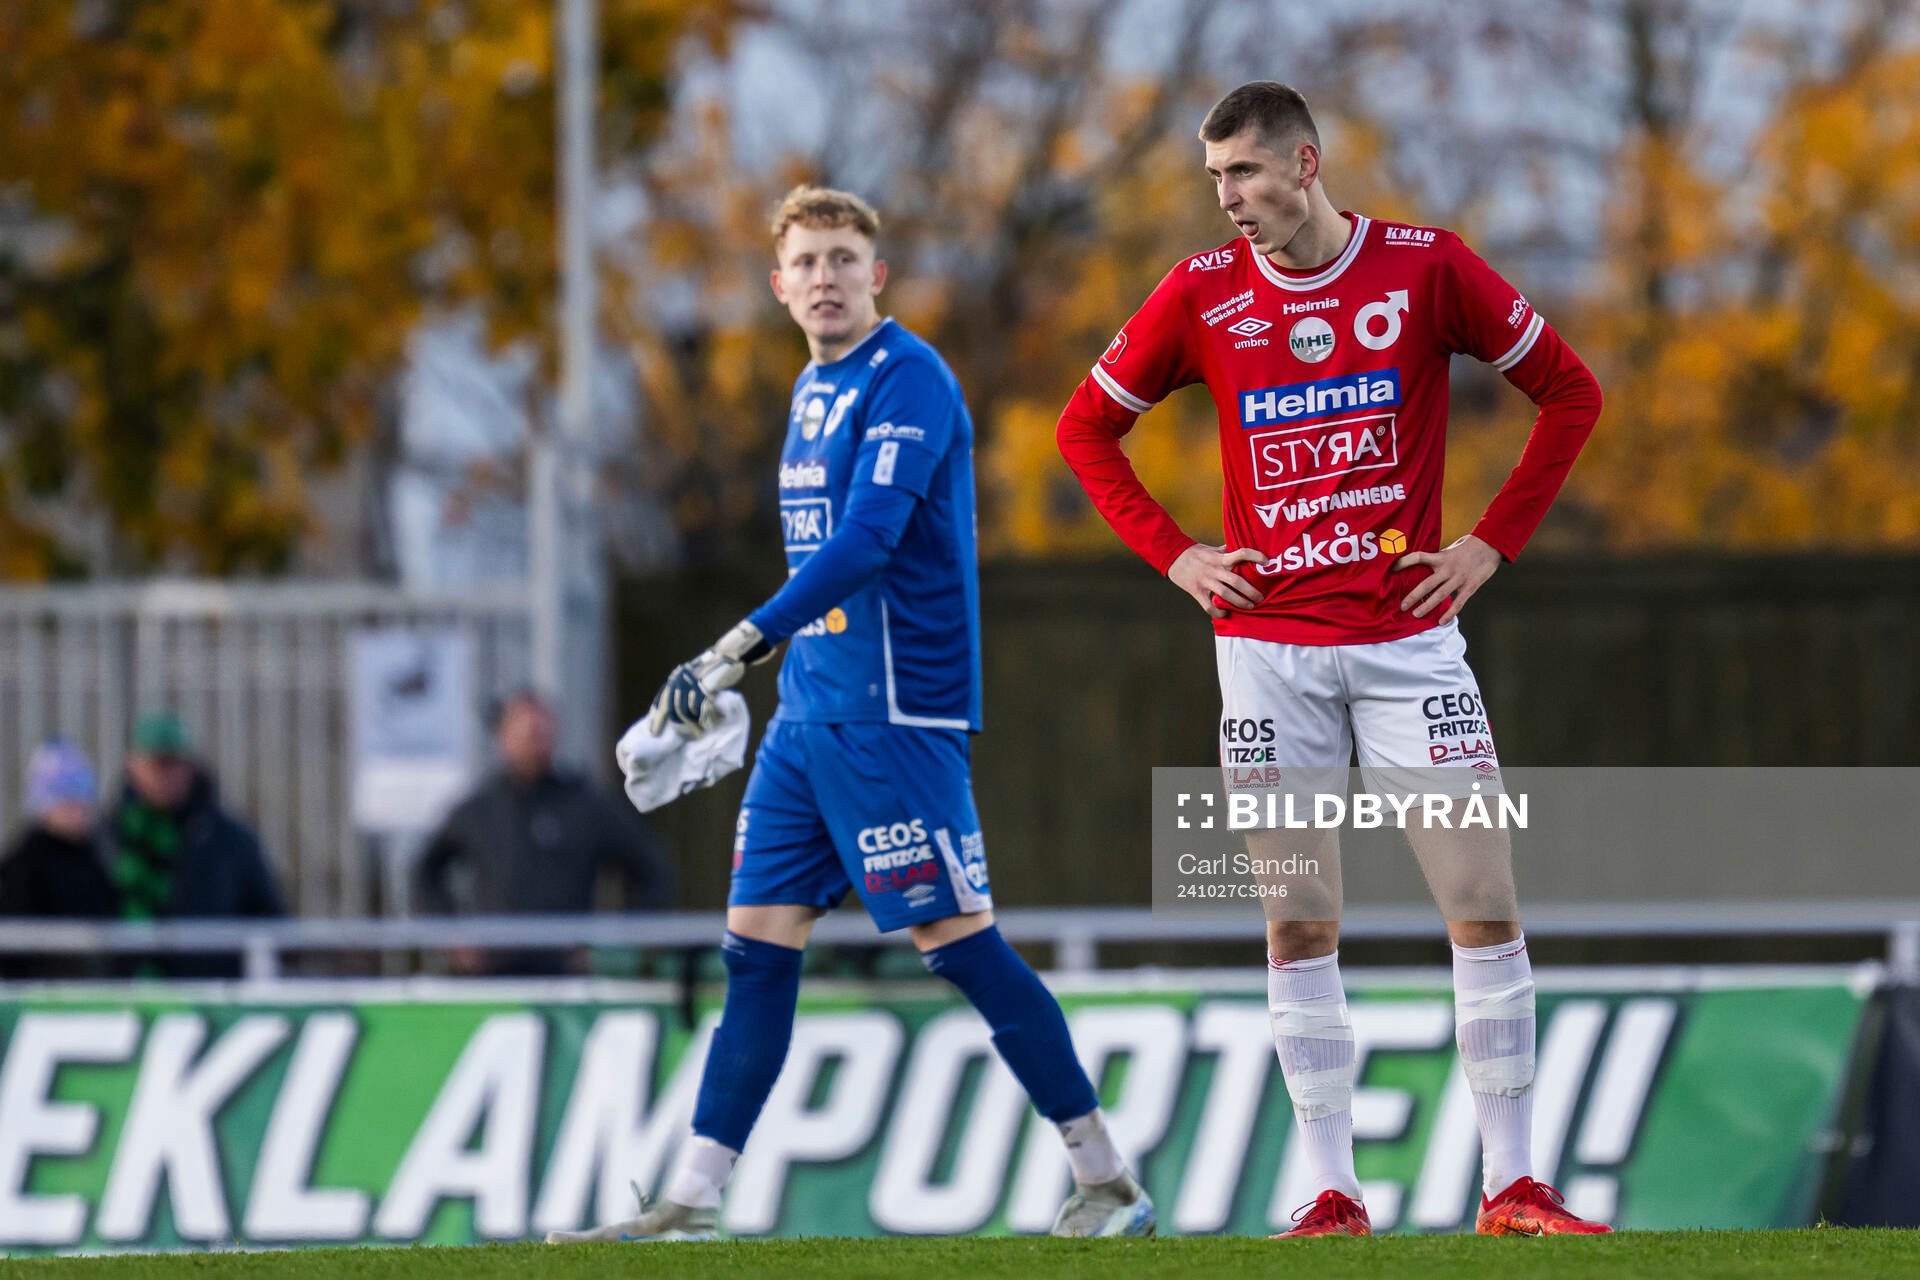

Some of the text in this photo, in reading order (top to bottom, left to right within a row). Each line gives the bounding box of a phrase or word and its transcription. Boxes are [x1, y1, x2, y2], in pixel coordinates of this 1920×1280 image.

[1385, 226, 1436, 242] KMAB
[1188, 249, 1234, 272] AVIS
[1236, 296, 1255, 312] gård
[1282, 297, 1340, 315] Helmia
[1234, 338, 1269, 350] umbro
[1290, 333, 1333, 350] MHE
[1245, 376, 1394, 422] Helmia
[1282, 483, 1407, 522] VÄSTANHEDE
[1255, 521, 1379, 575] askås
[1429, 739, 1494, 761] D-LAB
[857, 818, 927, 854] CEOS
